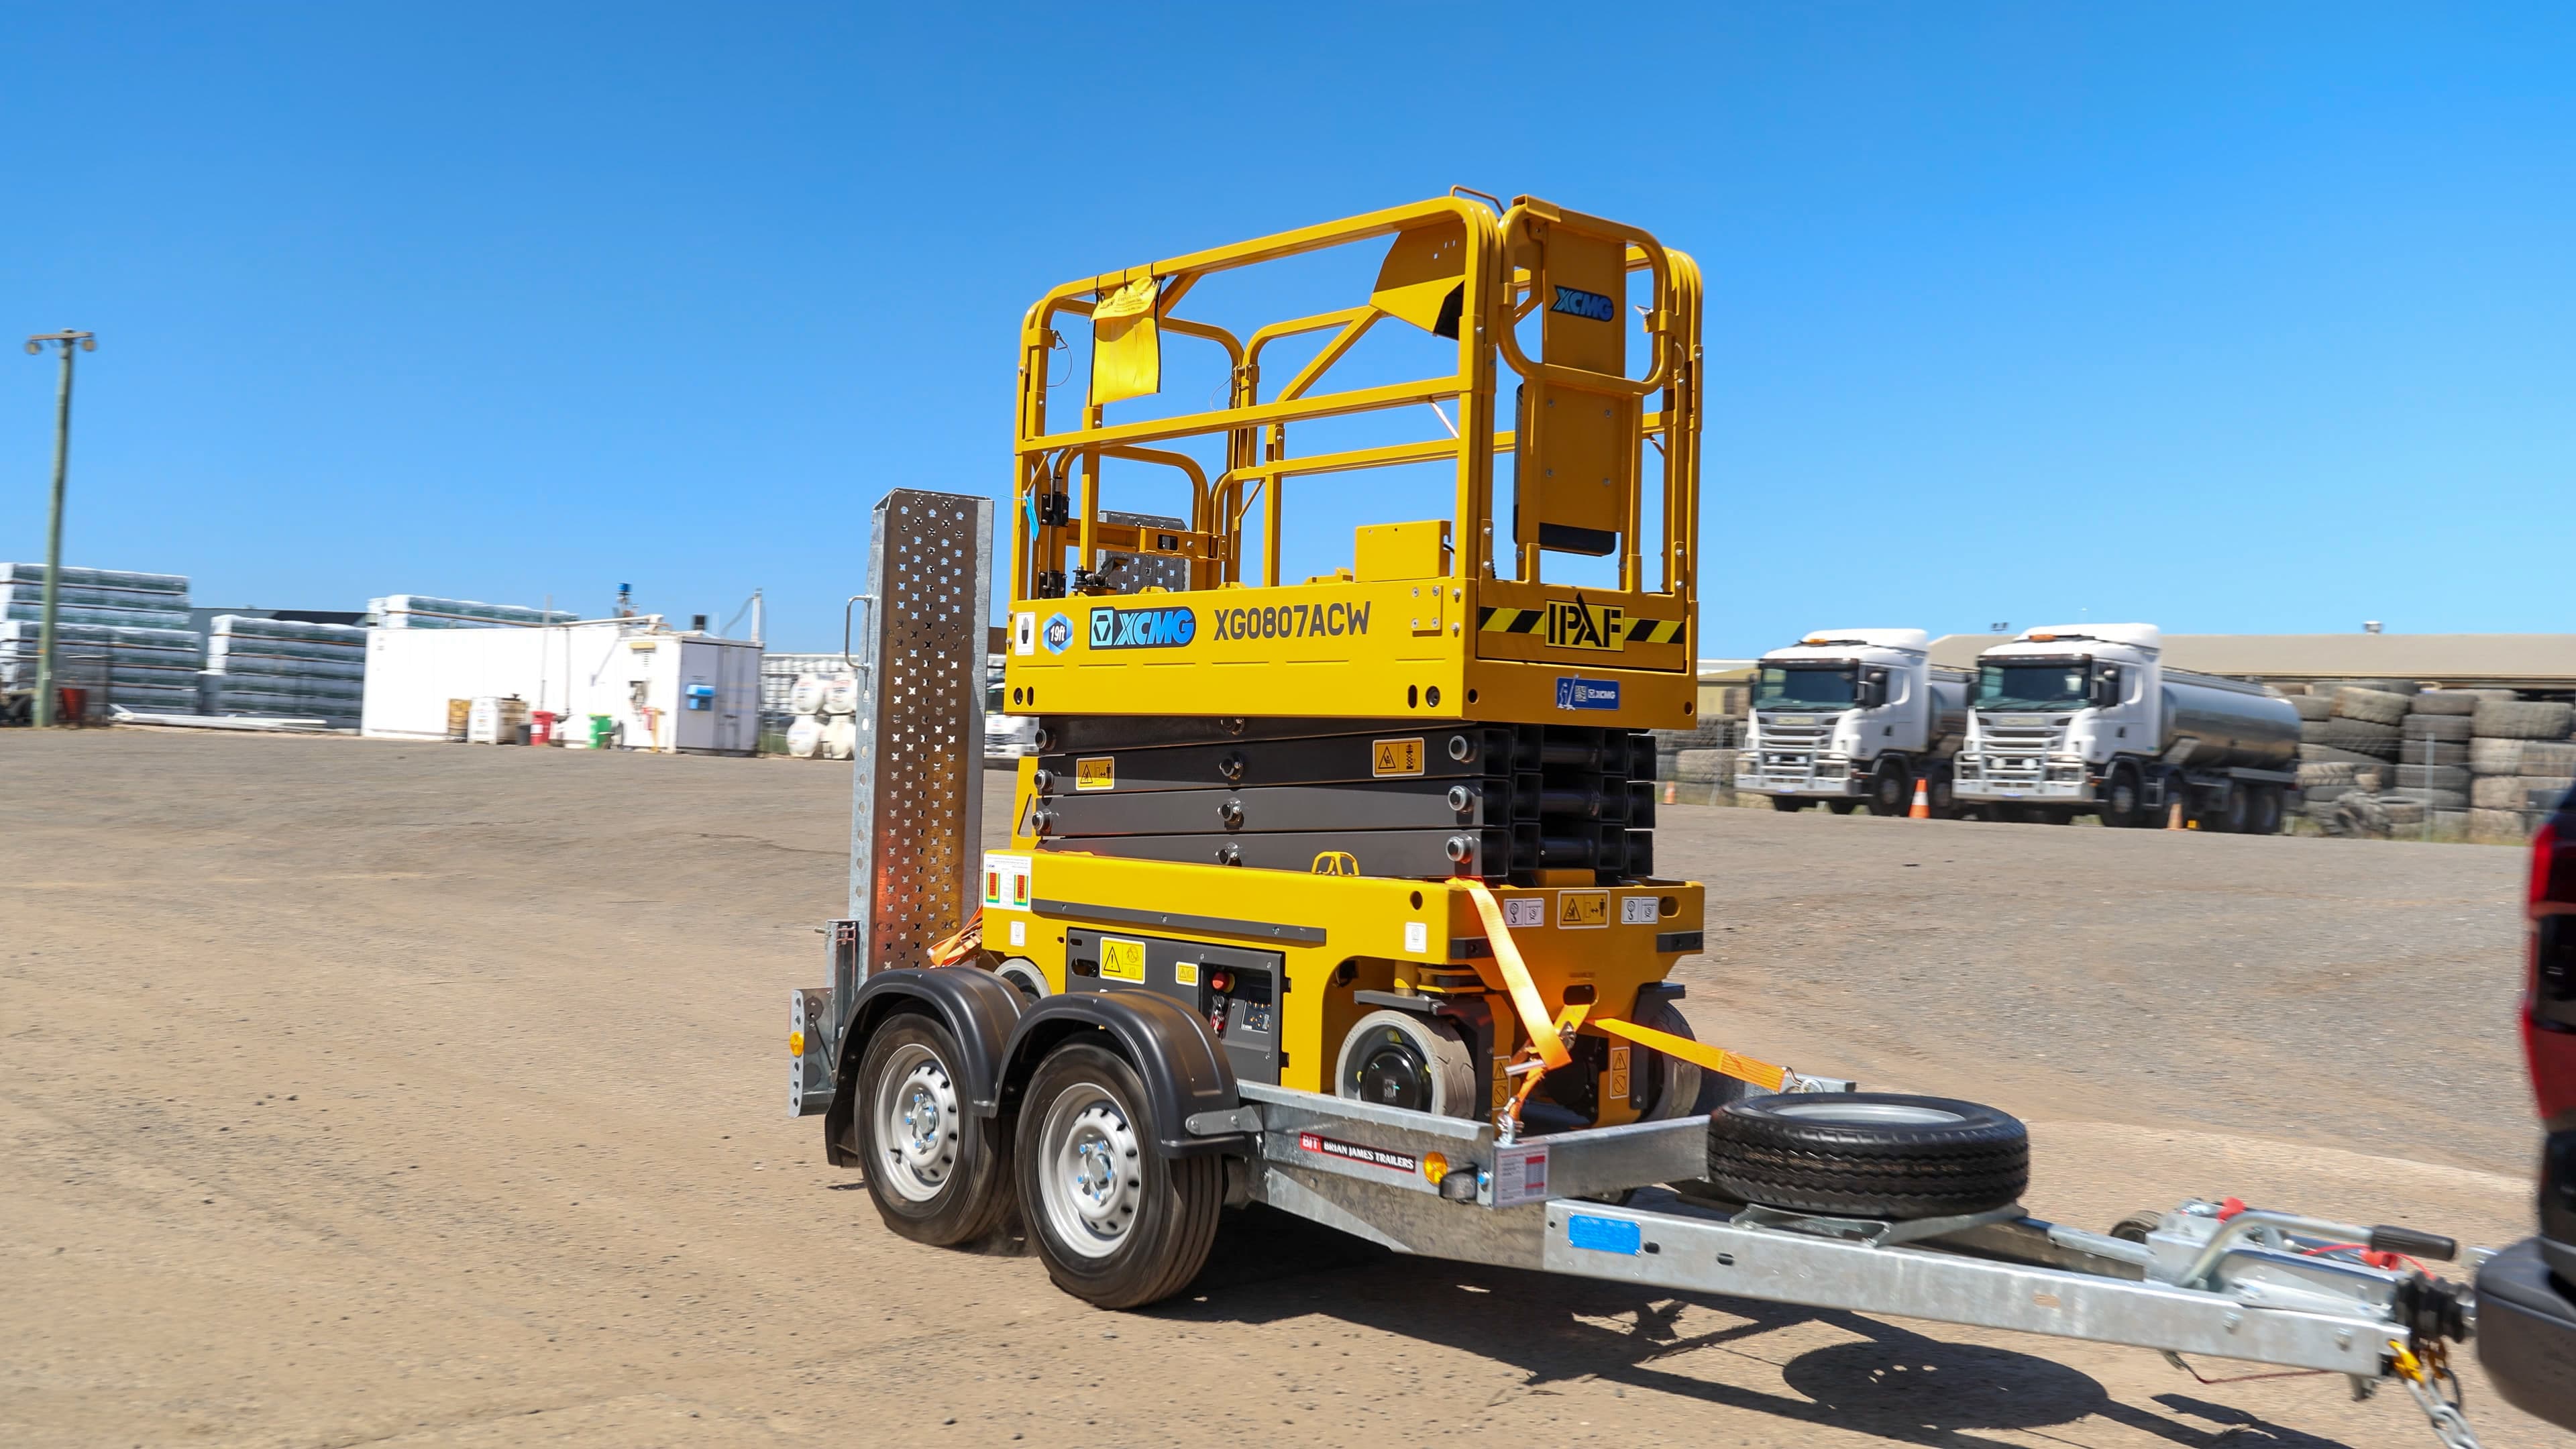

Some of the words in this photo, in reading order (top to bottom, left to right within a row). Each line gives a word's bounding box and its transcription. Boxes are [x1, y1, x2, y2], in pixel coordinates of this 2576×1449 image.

[1552, 286, 1613, 321] XCMG
[1050, 625, 1066, 641] 19ft
[1113, 609, 1194, 645] XCMG
[1214, 601, 1371, 641] XG0807ACW
[1548, 592, 1621, 647] IPAF
[1324, 1141, 1348, 1155] BRIAN
[1348, 1147, 1374, 1161] JAMES
[1375, 1152, 1414, 1170] TRAILERS
